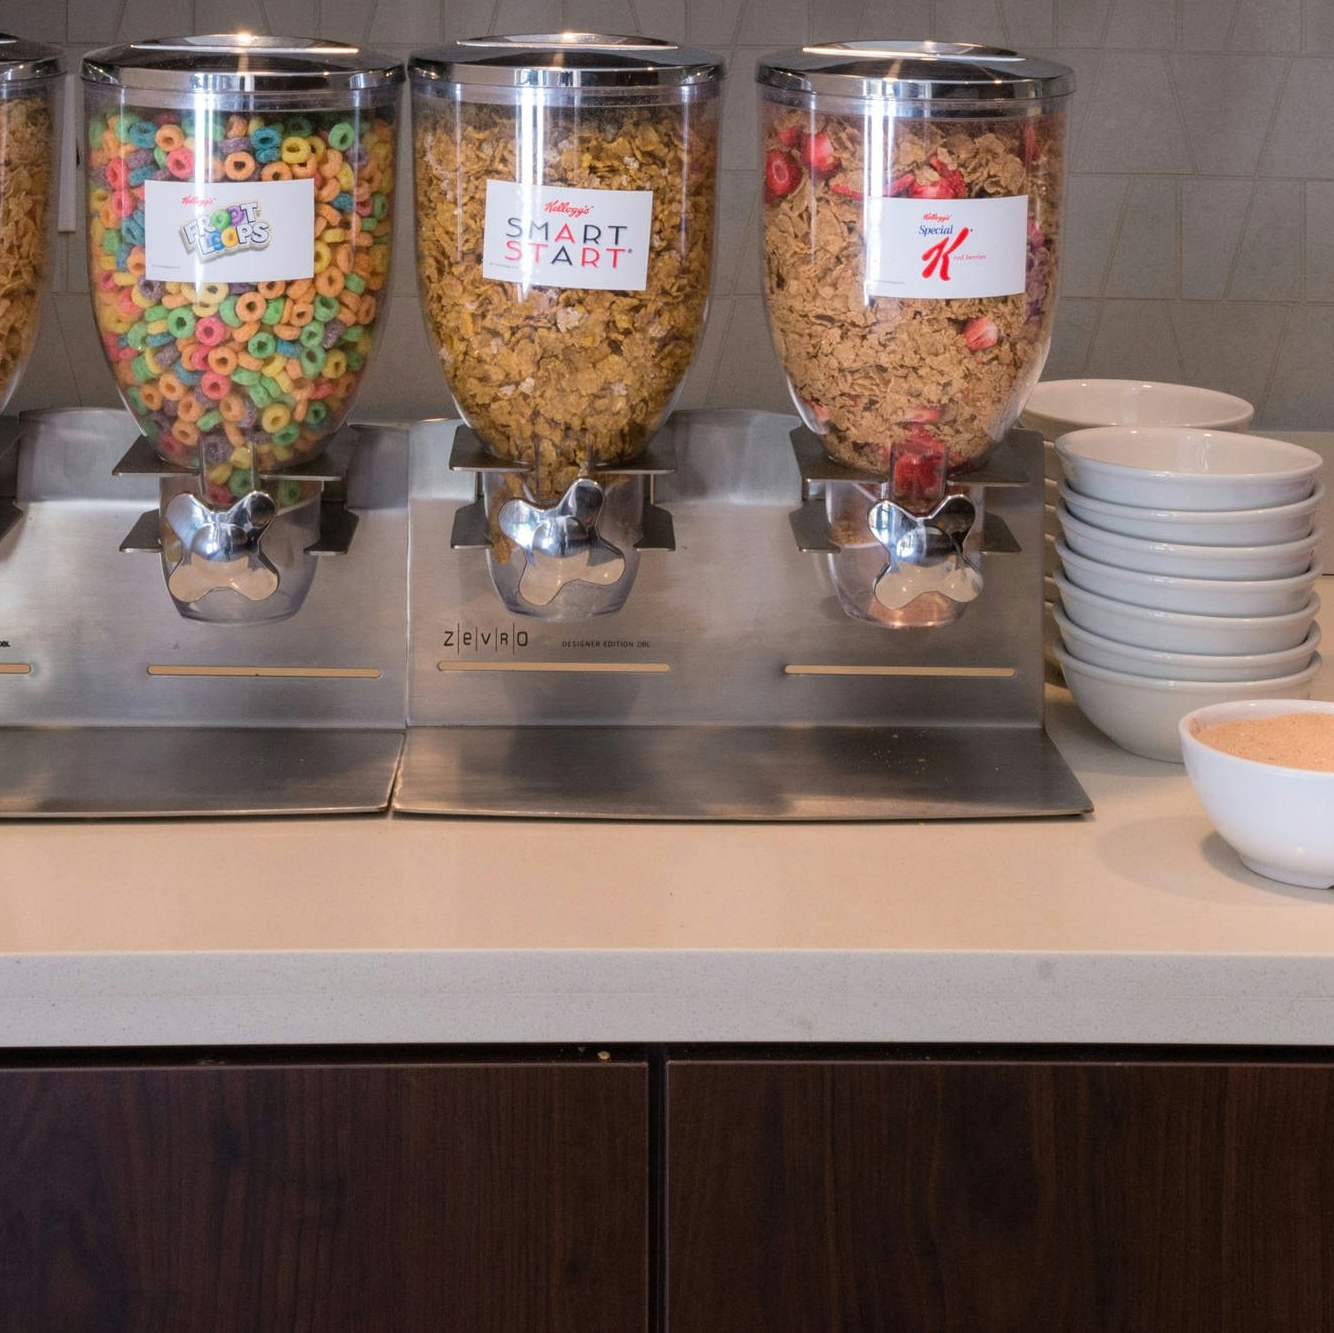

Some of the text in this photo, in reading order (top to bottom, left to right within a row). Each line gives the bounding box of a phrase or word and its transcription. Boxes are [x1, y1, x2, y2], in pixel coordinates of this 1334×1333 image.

[182, 201, 259, 245] FROOT
[544, 200, 591, 218] Kellogg's
[197, 221, 270, 256] LOOPS
[505, 217, 628, 246] SMART
[918, 224, 953, 238] Special
[504, 240, 627, 269] START
[921, 227, 969, 281] K
[562, 640, 601, 648] DESIGNER
[603, 640, 634, 648] EDITION
